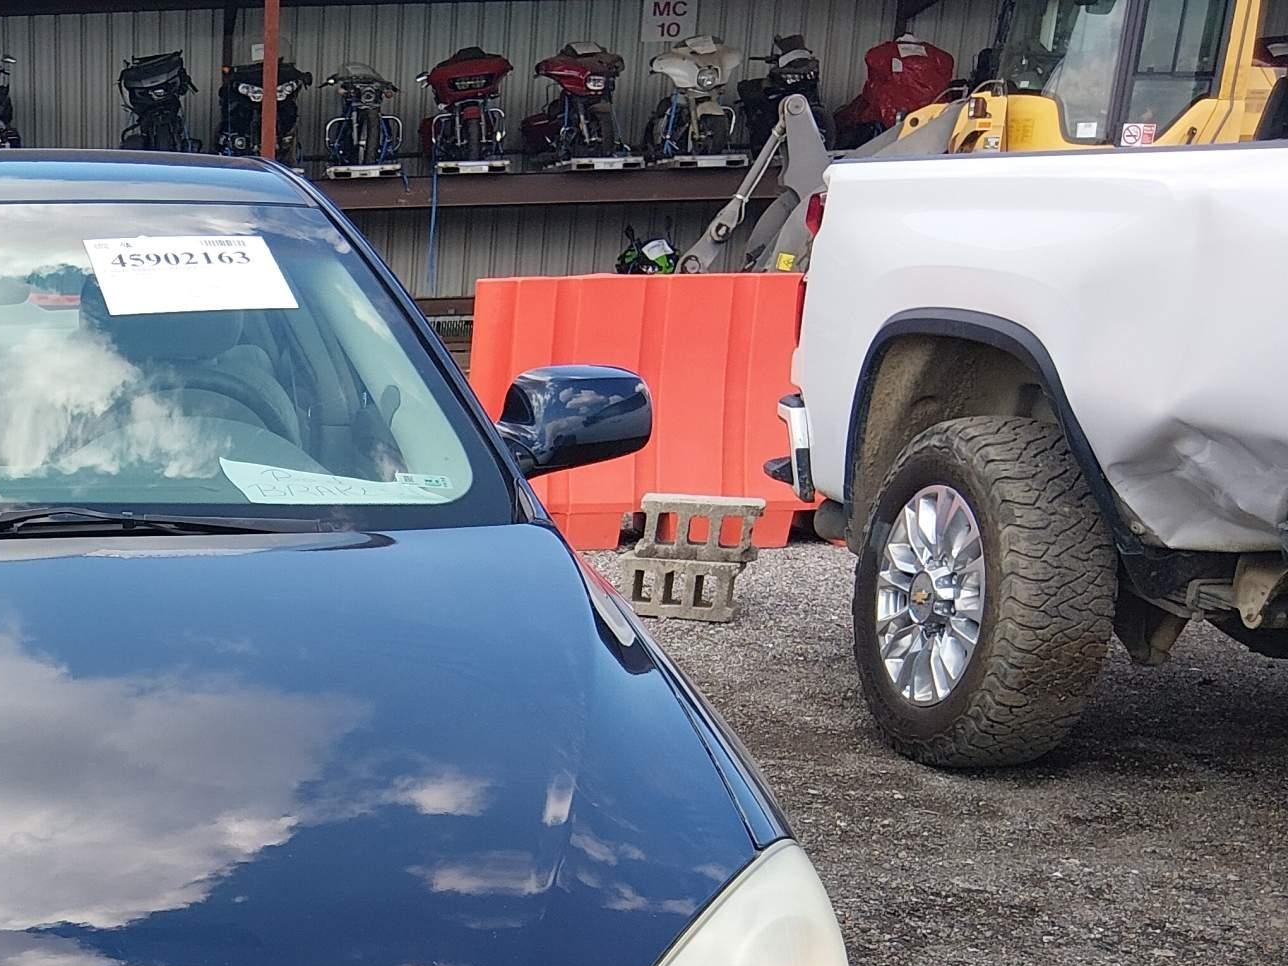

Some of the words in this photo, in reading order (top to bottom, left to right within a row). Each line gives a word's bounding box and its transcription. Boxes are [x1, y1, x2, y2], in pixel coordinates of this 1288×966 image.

[653, 1, 688, 17] MC
[656, 22, 681, 37] 10
[111, 251, 251, 268] 45902163
